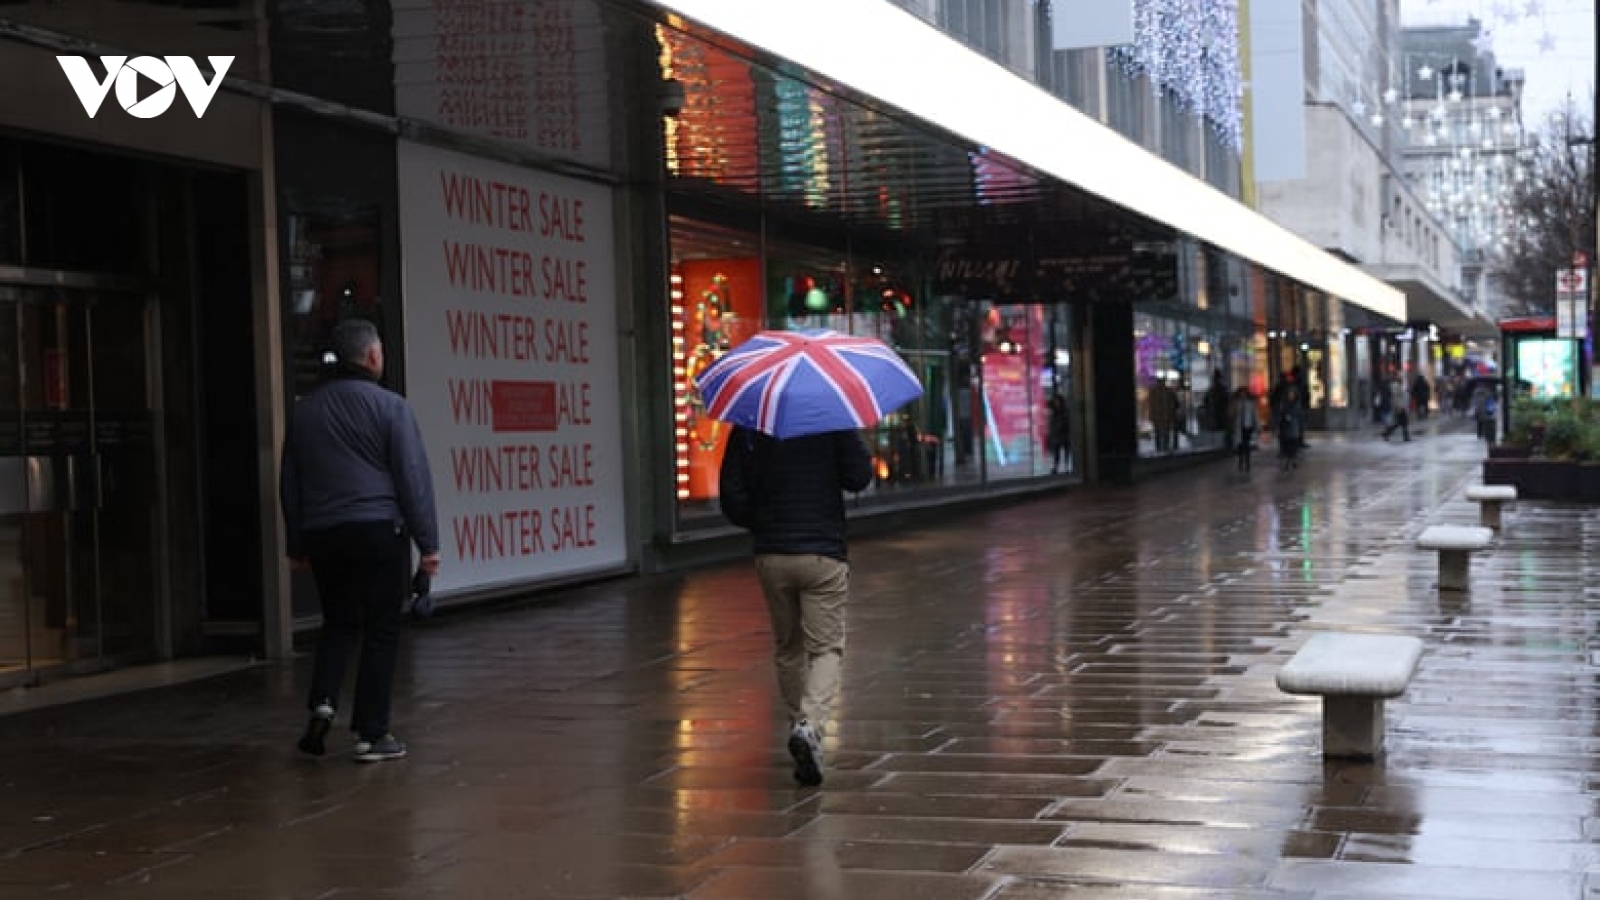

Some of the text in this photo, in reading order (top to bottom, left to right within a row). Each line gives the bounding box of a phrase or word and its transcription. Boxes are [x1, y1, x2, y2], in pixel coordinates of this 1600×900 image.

[440, 169, 585, 242] WINTER SALE
[443, 239, 588, 303] WINTER SALE
[446, 309, 590, 364] WINTER SALE
[449, 378, 493, 426] WIN
[557, 382, 592, 426] ALE
[451, 443, 594, 493] WINTER SALE
[452, 503, 597, 563] WINTER SALE
